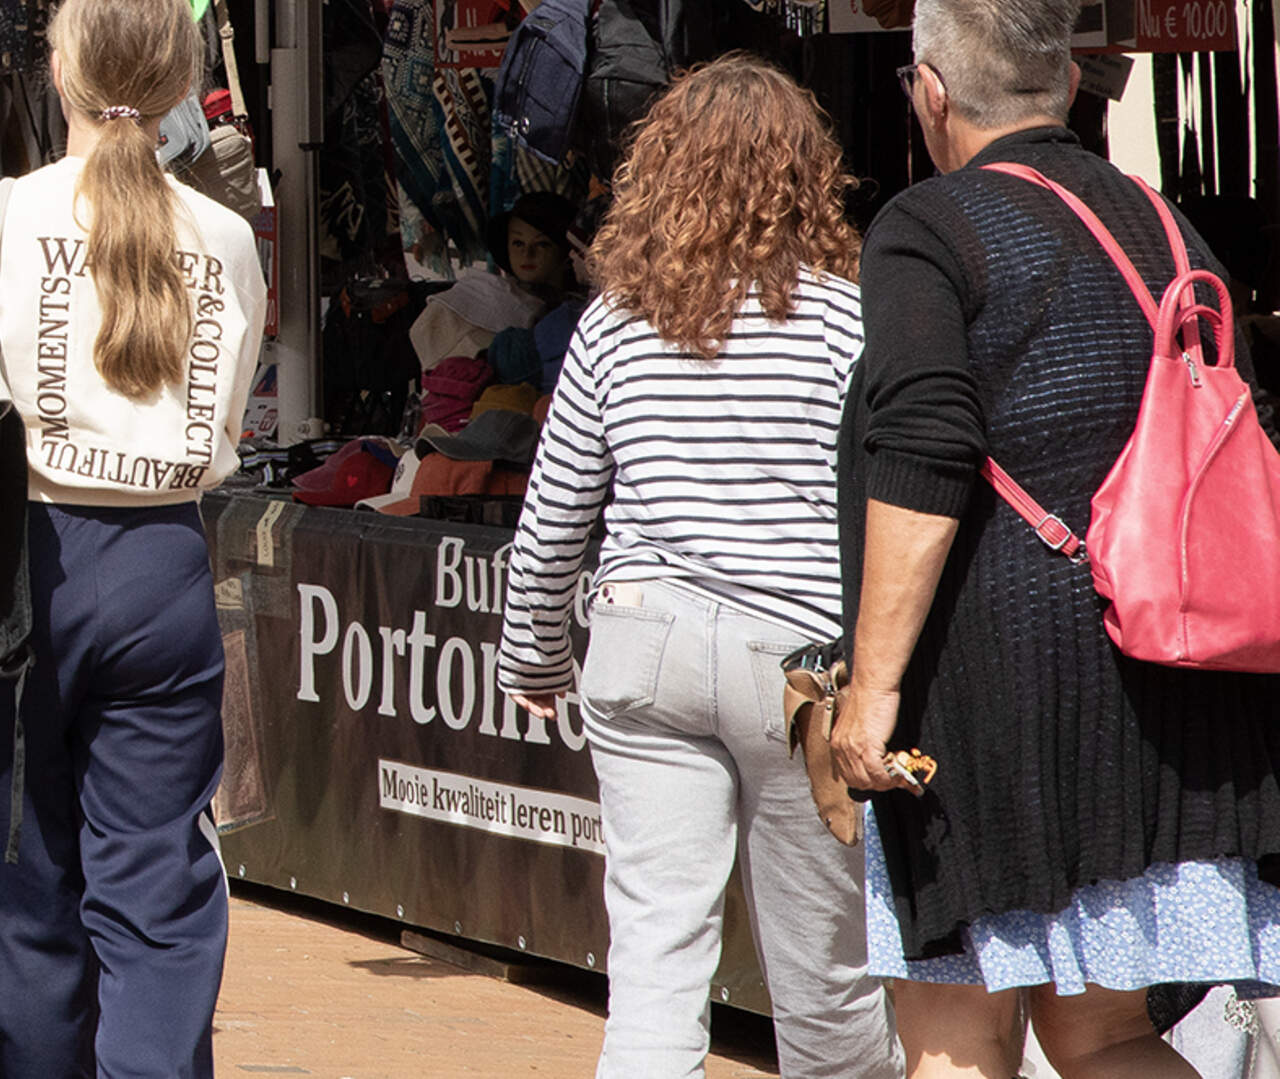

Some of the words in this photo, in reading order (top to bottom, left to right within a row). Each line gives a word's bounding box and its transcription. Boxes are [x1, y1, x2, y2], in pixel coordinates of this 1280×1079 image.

[1165, 6, 1178, 39] €
[37, 276, 71, 441] MOMENTS
[41, 440, 208, 490] BEAUTIFUL
[381, 768, 428, 808] Mooie
[432, 777, 507, 825] kwaliteit
[510, 793, 566, 835] leren
